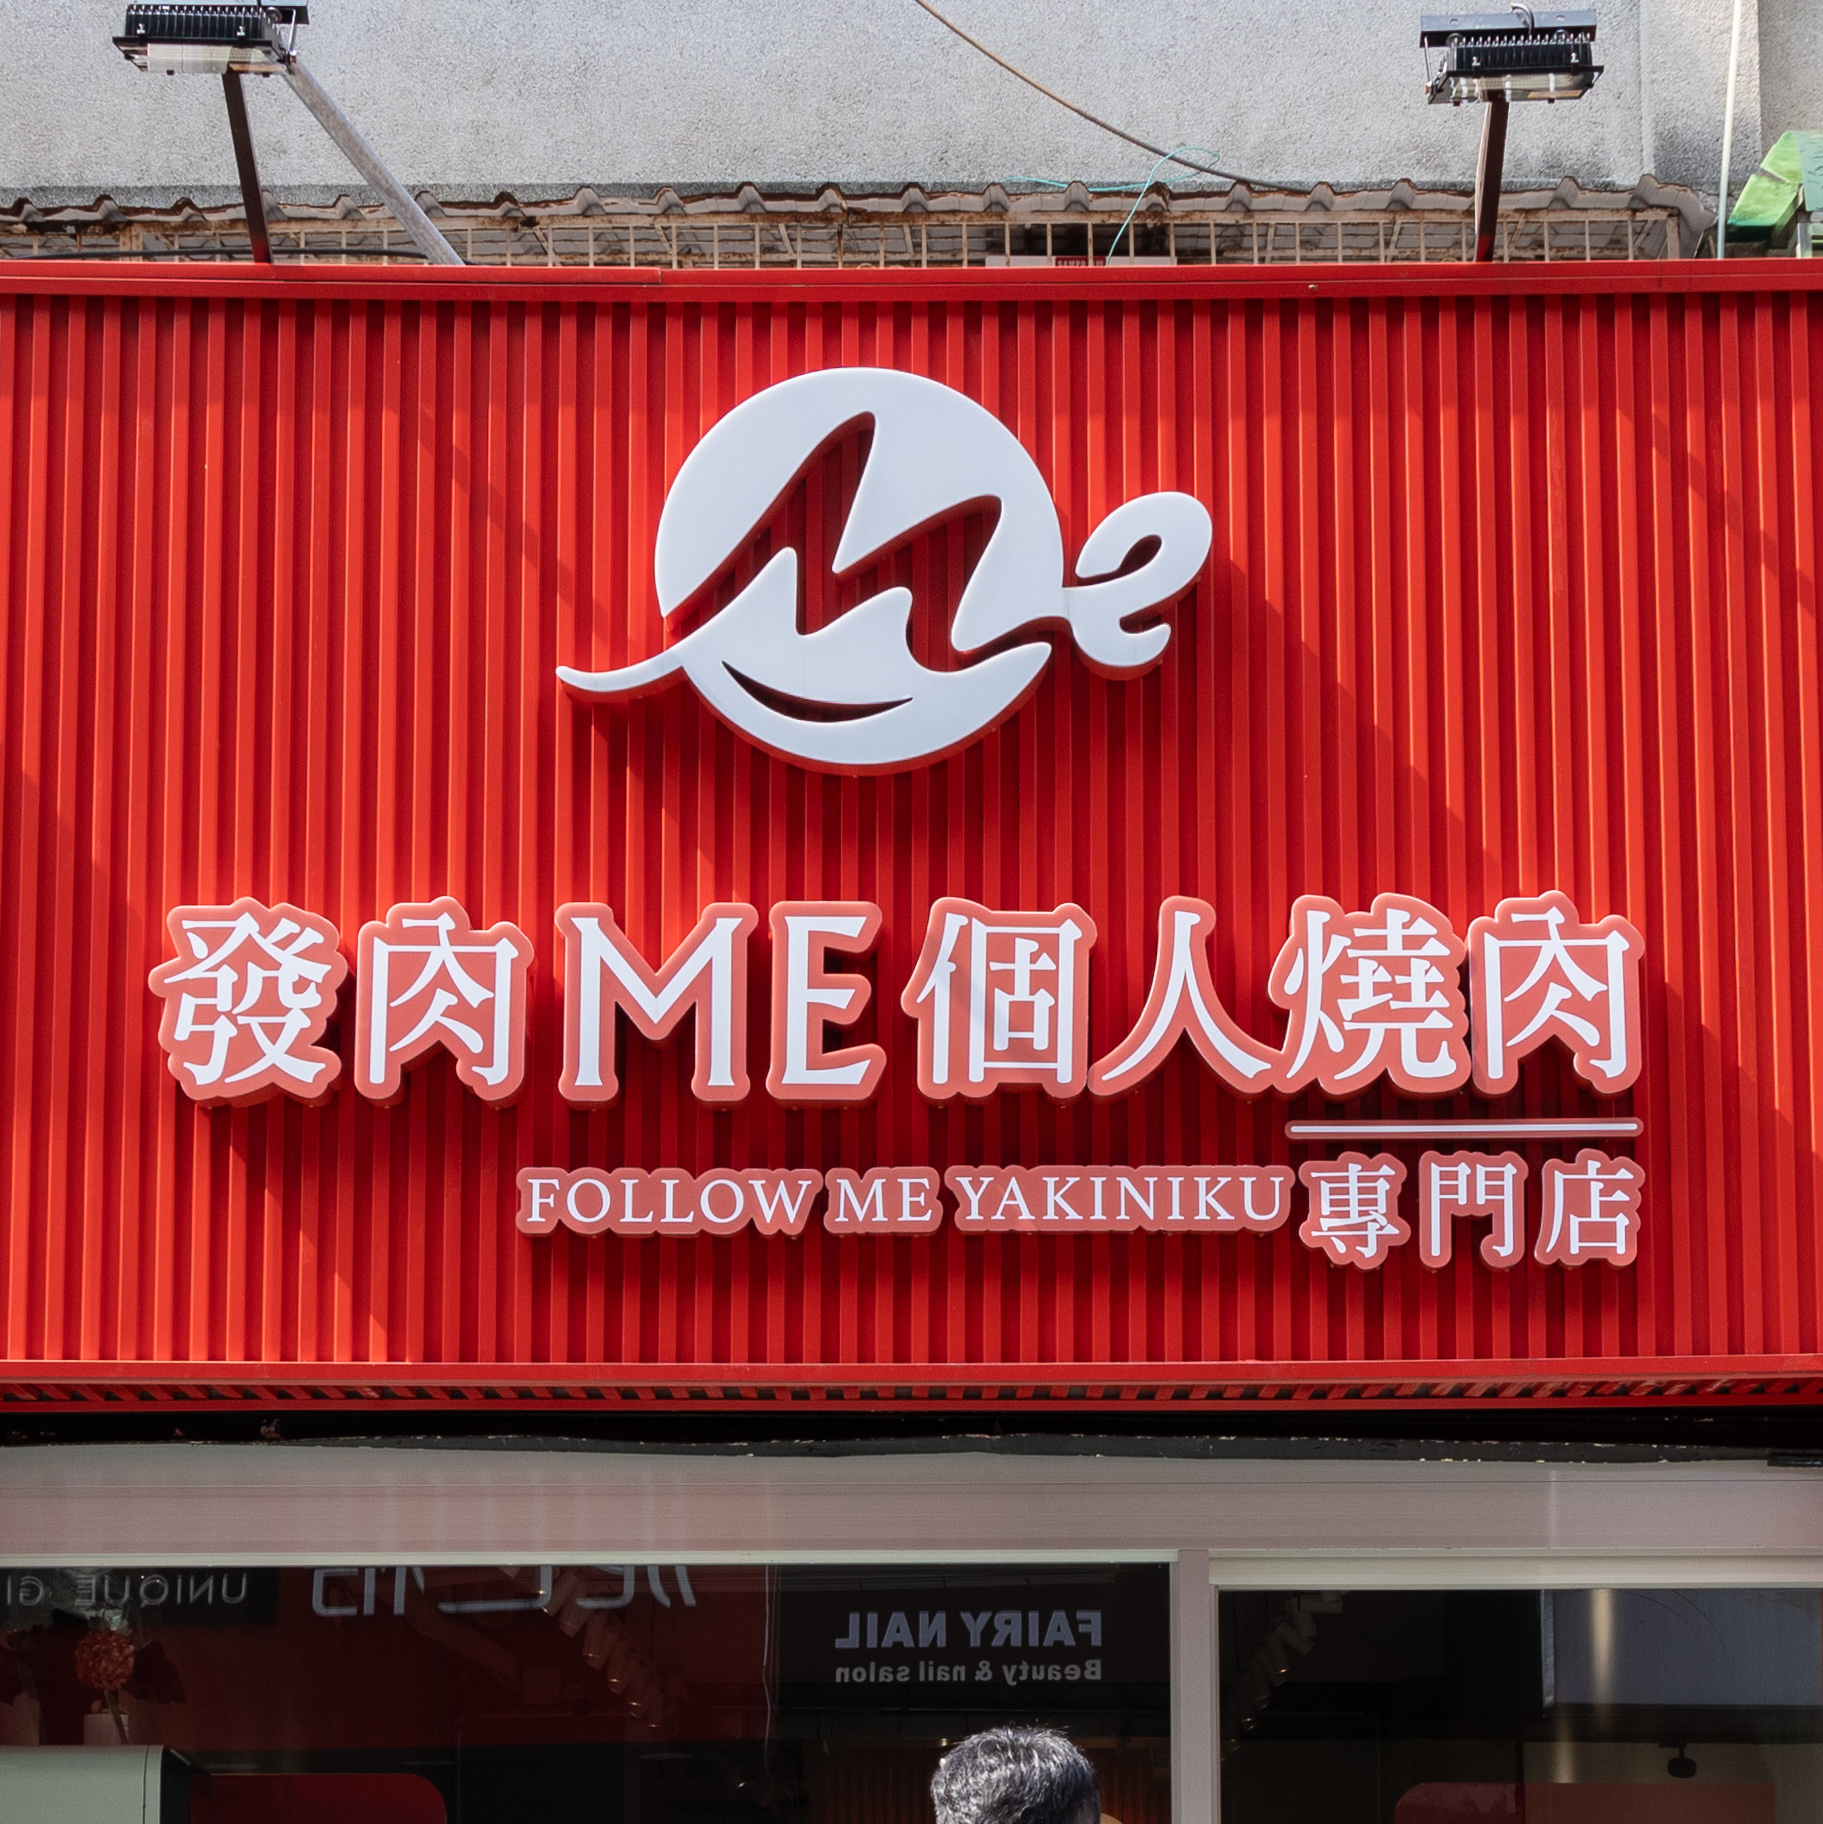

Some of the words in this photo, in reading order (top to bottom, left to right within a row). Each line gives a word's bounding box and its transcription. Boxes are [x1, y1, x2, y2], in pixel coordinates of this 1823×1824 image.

[526, 1172, 814, 1225] FOLLOW
[833, 1174, 934, 1223] ME
[954, 1170, 1285, 1222] YAKINIKU
[1307, 1156, 1636, 1262] 專門店
